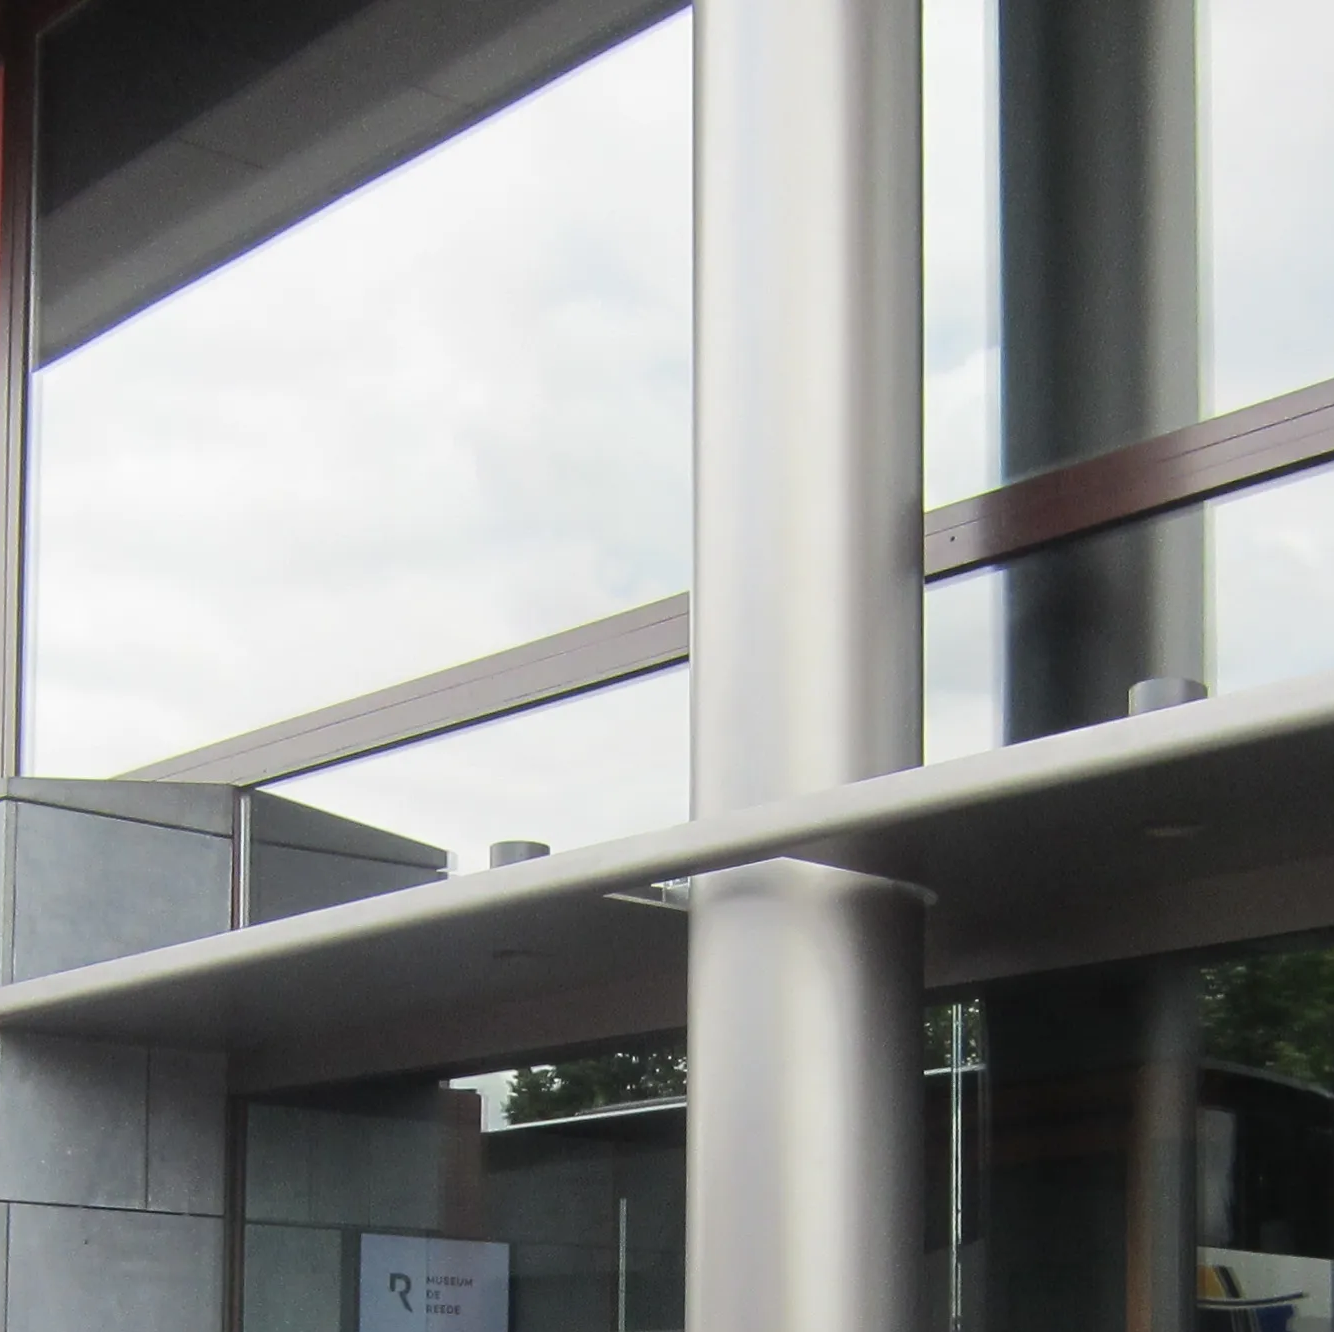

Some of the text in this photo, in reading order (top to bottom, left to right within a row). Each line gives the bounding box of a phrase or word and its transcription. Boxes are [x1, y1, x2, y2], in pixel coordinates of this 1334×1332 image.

[425, 1276, 473, 1287] MUSEUM
[425, 1290, 441, 1300] DE
[425, 1304, 461, 1315] REEDE
